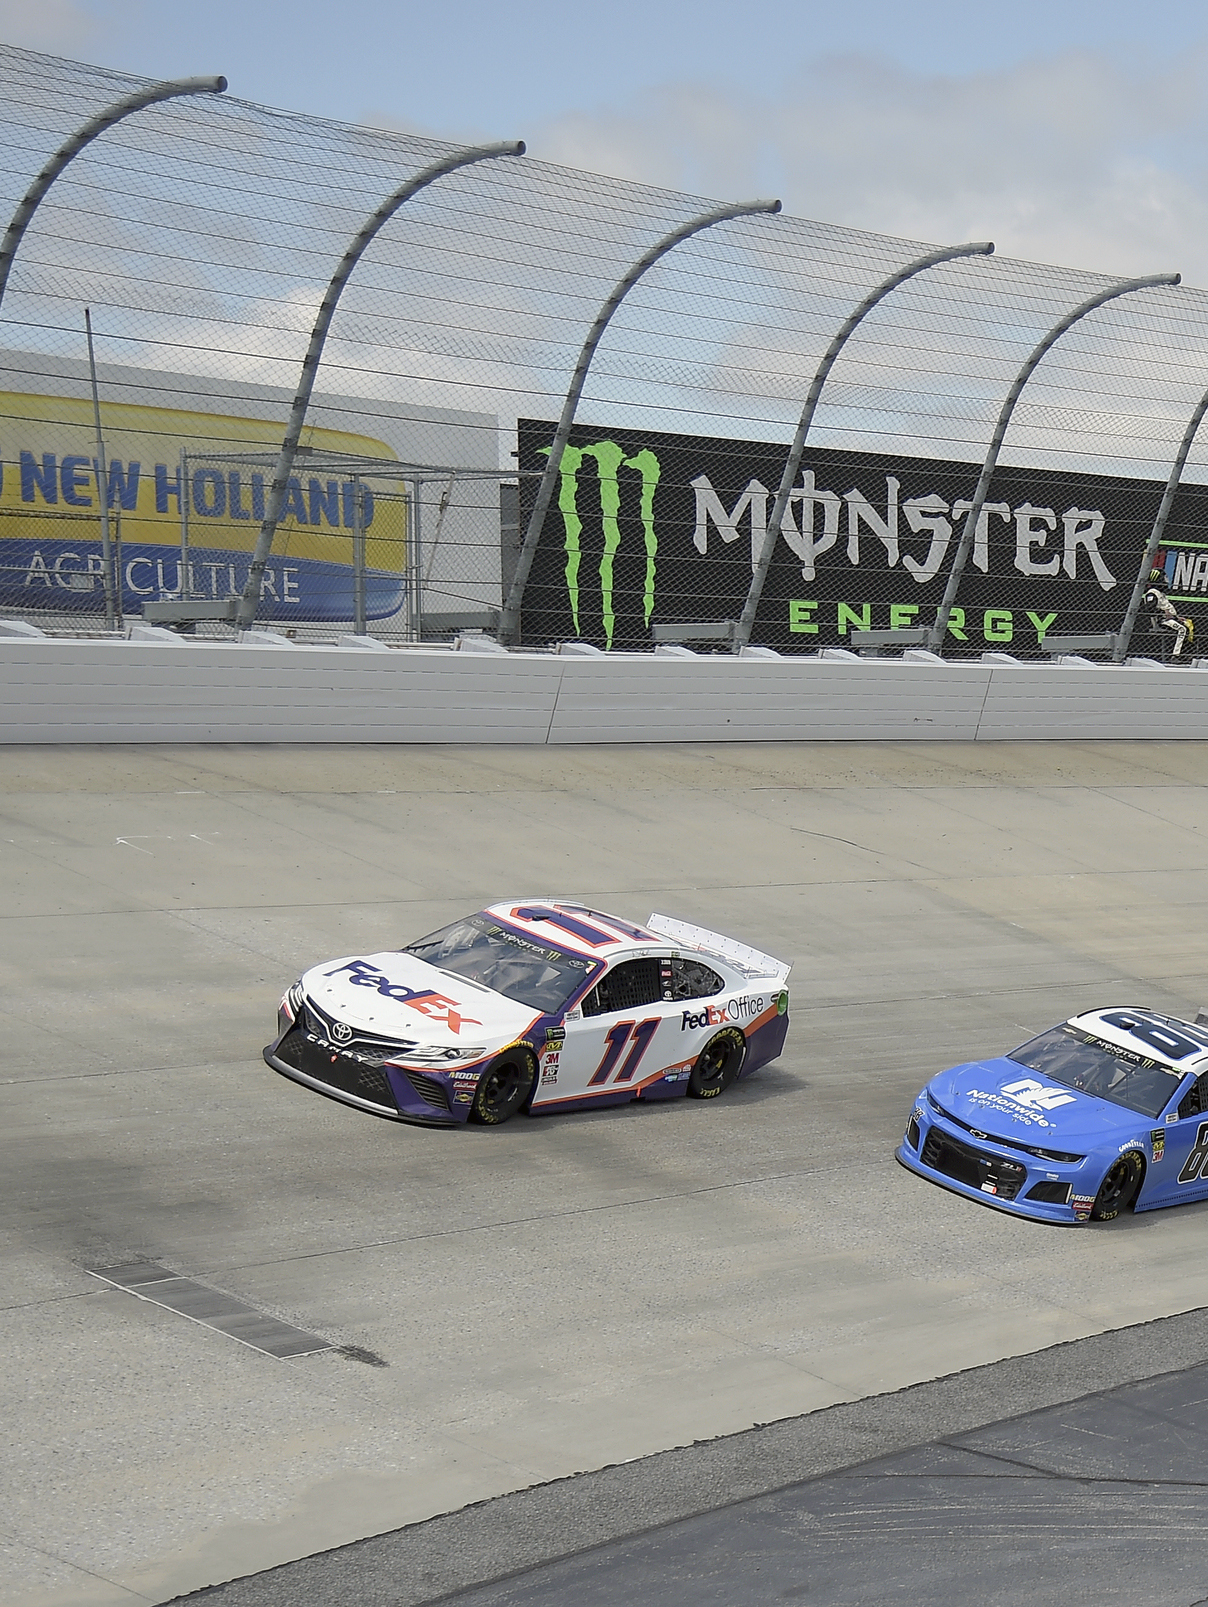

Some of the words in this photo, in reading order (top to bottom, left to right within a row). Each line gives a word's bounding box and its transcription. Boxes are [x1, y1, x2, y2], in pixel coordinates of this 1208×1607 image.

[19, 450, 141, 511] NEW
[154, 463, 375, 529] HOLLAND
[689, 469, 1117, 591] MONSTER
[788, 599, 1059, 644] ENERGY
[322, 960, 484, 1035] FedEx
[681, 1004, 730, 1032] FedEx
[727, 995, 765, 1021] Office
[306, 1033, 369, 1063] CAMRY
[545, 1053, 560, 1065] 3M
[586, 1016, 663, 1087] 11
